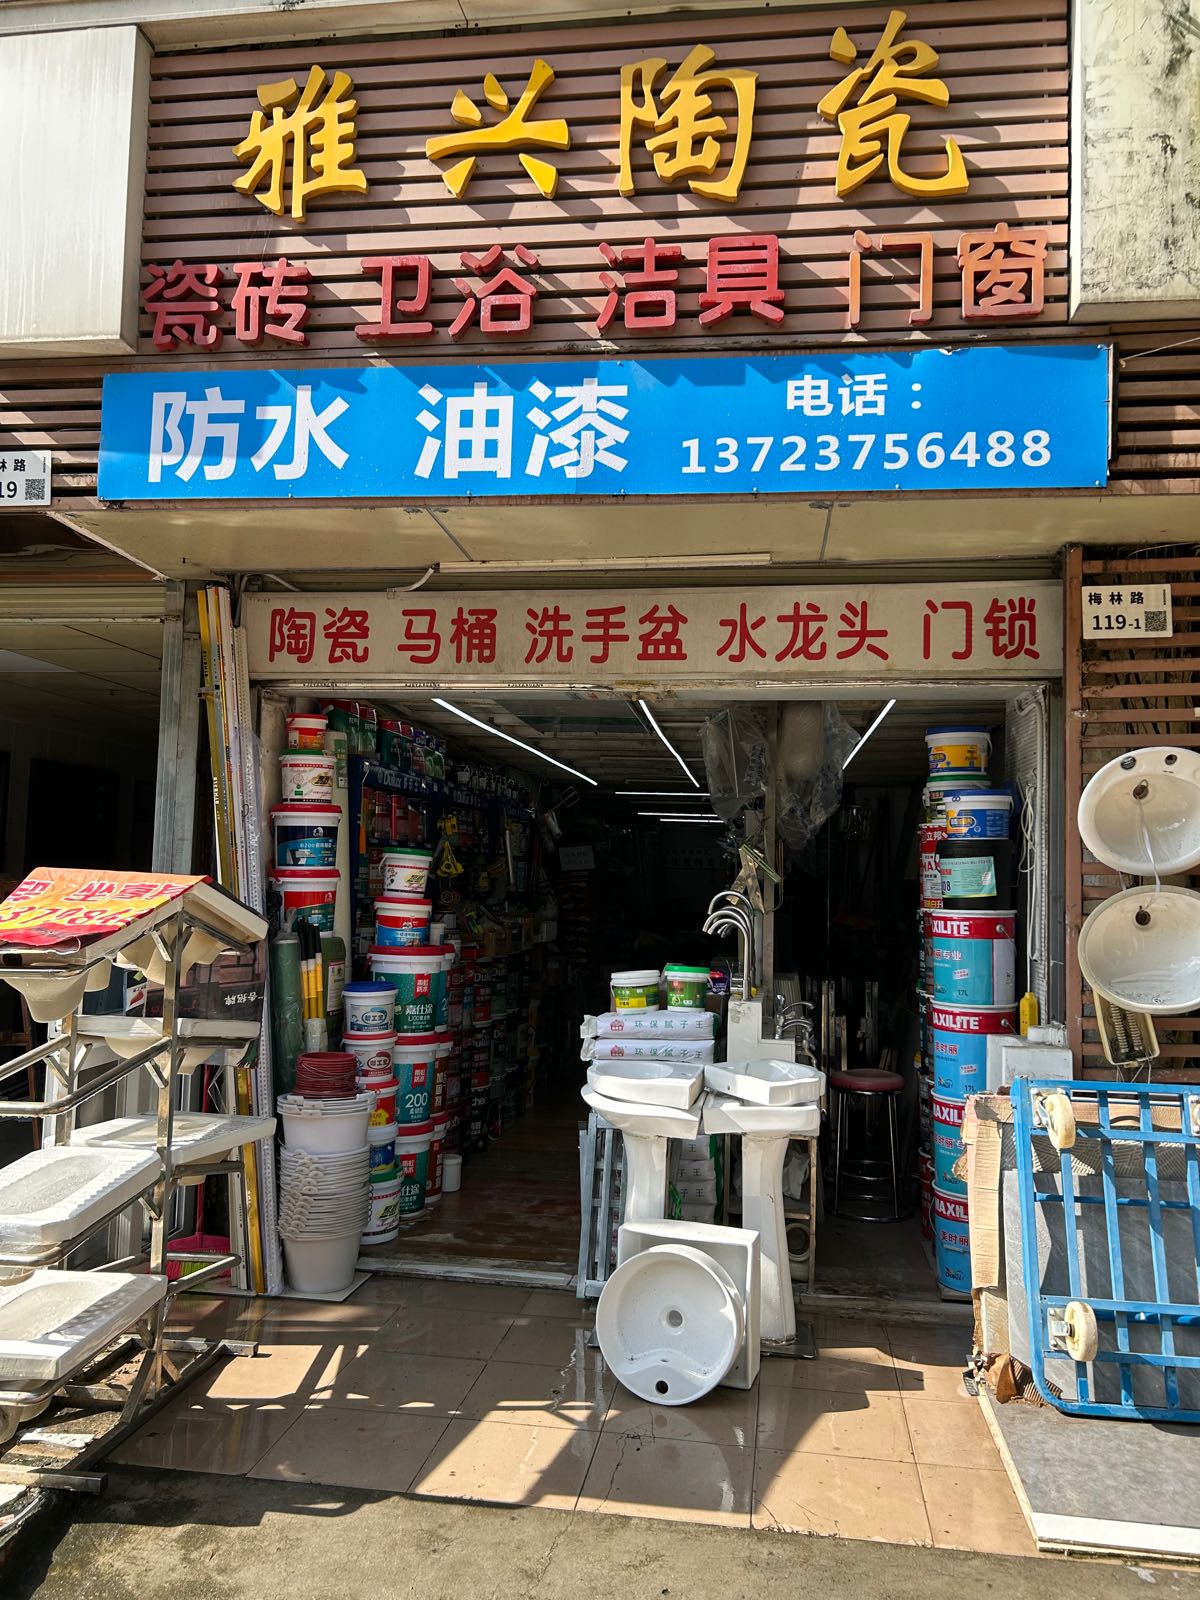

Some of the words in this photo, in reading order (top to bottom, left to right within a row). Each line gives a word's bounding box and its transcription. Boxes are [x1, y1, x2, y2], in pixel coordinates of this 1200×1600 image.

[232, 10, 969, 222] 雅兴陶瓷
[143, 257, 311, 352] 瓷砖
[354, 244, 538, 341] 卫浴
[597, 235, 785, 337] 洁具
[848, 222, 1048, 329] 门窗
[148, 384, 350, 483] 防水
[414, 376, 629, 480] 油漆
[786, 372, 922, 418] 电话：
[681, 429, 1052, 475] 13723756488
[1088, 591, 1144, 606] 梅林路
[268, 606, 370, 664] 陶瓷
[397, 607, 498, 664] 马桶
[524, 604, 688, 664] 洗手盆
[716, 600, 889, 663] 水龙头
[922, 596, 1040, 661] 门锁
[1092, 614, 1142, 631] 119-1
[931, 920, 970, 935] XILITE
[634, 1019, 705, 1030] 环保腻子王
[634, 1047, 703, 1059] 环保腻子王
[405, 1092, 428, 1108] 200
[688, 1143, 696, 1153] 王
[677, 1168, 702, 1178] 子王
[680, 1188, 704, 1198] 子王
